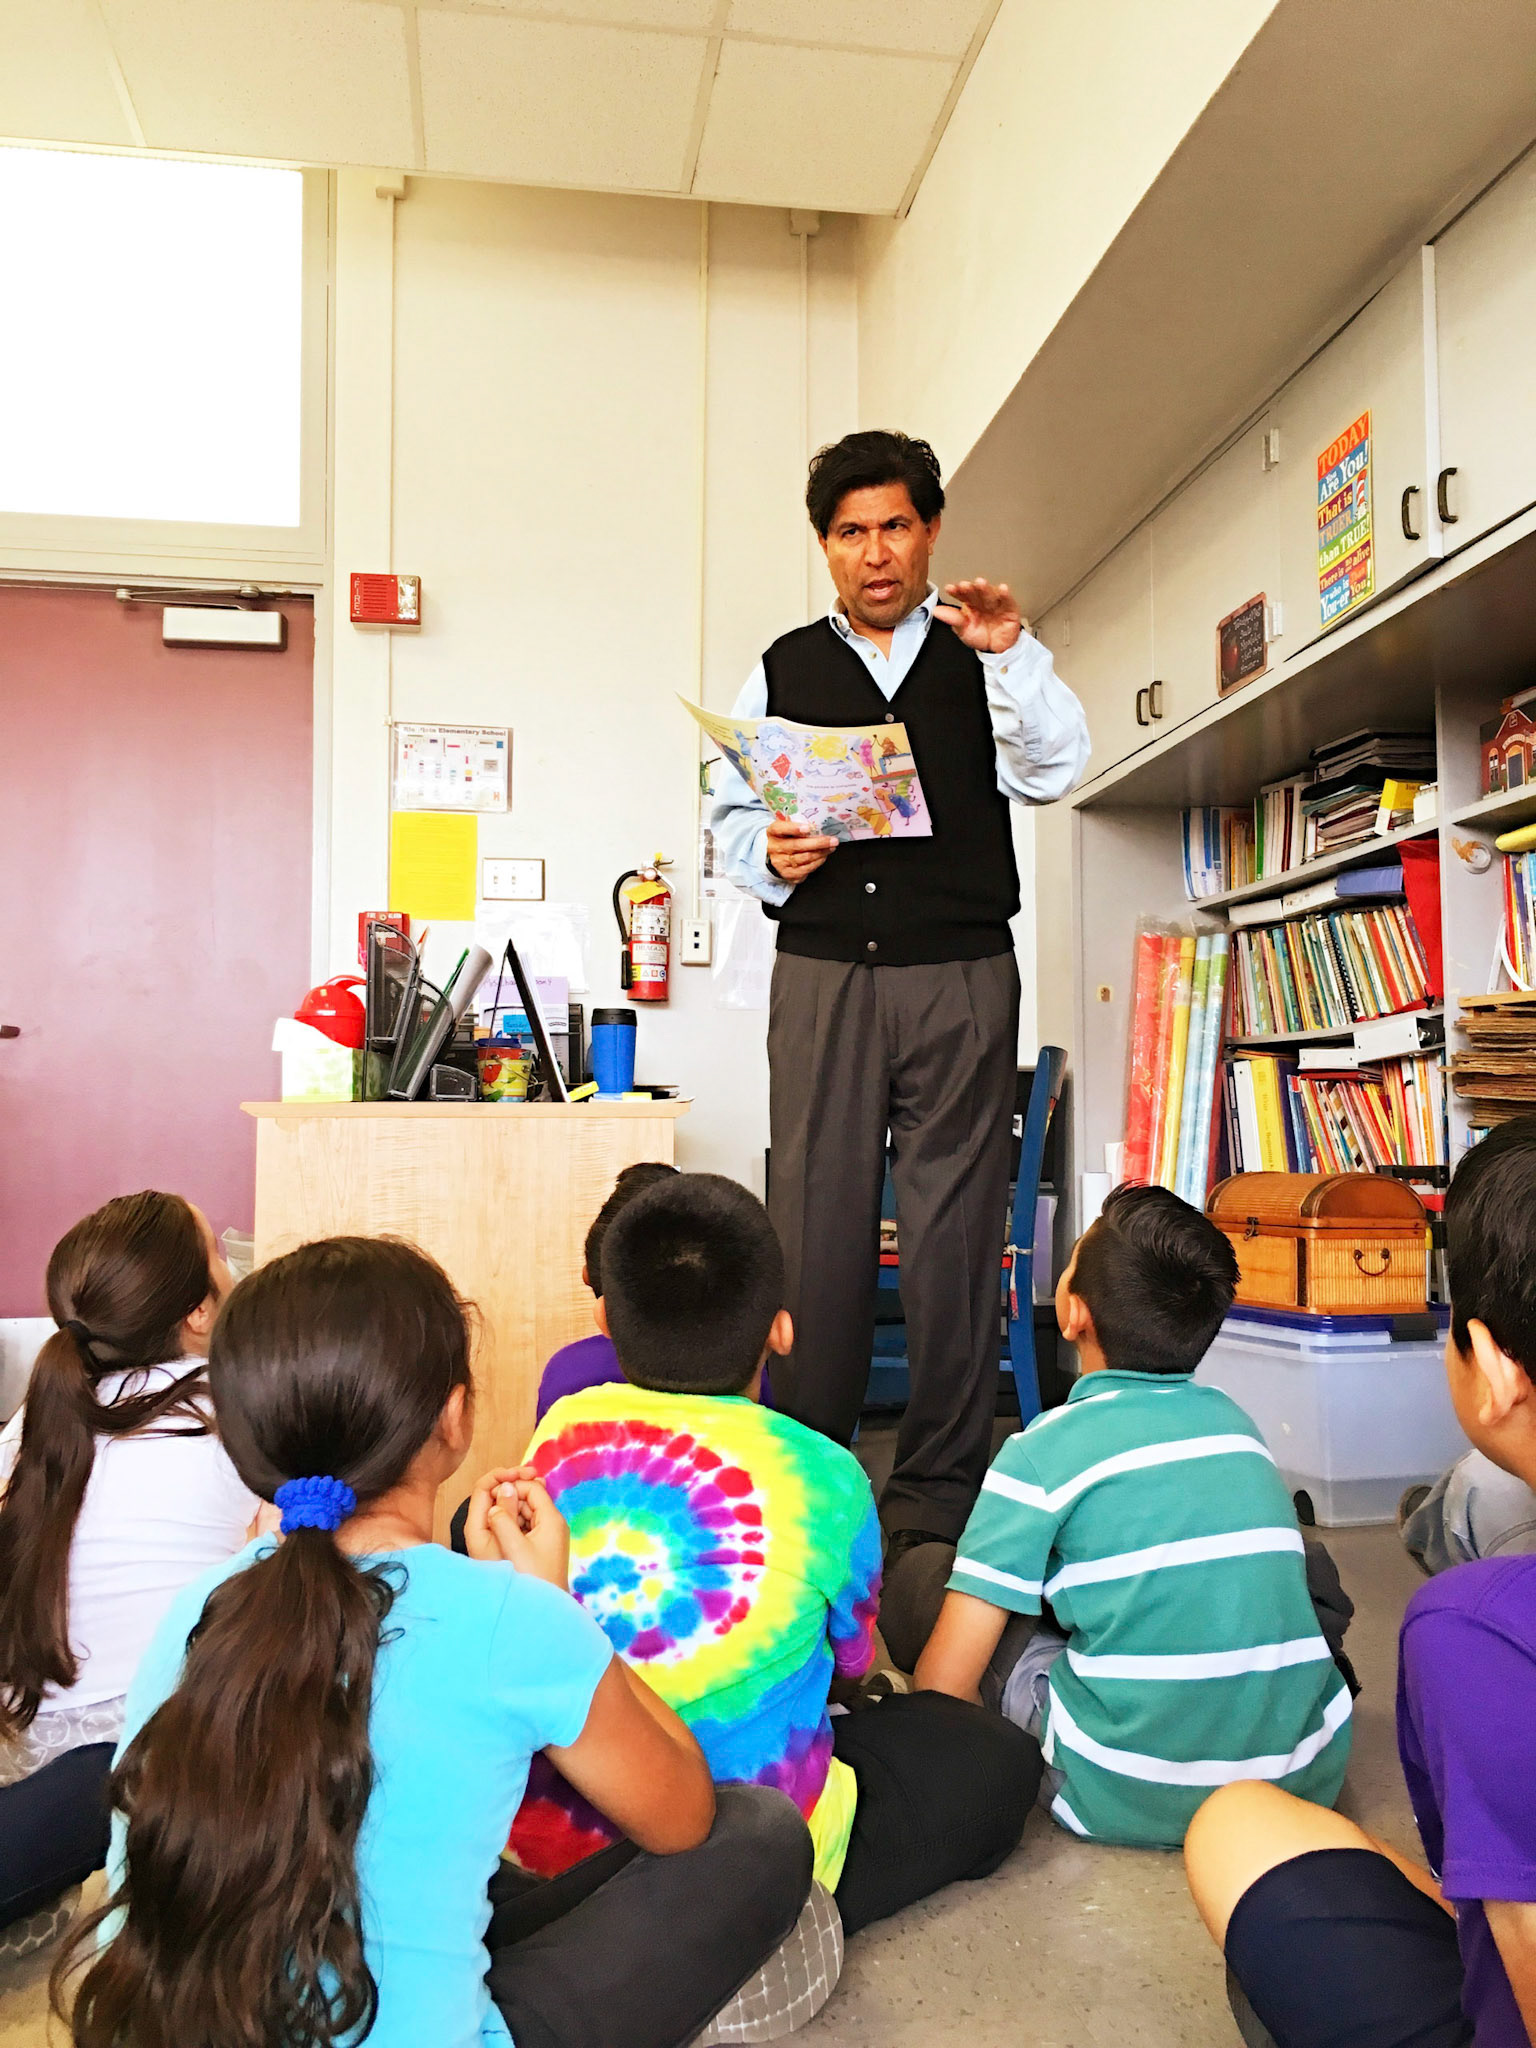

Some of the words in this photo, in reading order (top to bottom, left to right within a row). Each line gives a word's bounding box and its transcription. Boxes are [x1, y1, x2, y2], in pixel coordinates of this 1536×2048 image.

[1319, 411, 1369, 475] TODAY
[1320, 477, 1339, 503] Are
[1340, 440, 1368, 483] You!
[1320, 497, 1342, 528] That
[1344, 490, 1352, 507] is
[1320, 509, 1352, 546] TRUER
[1320, 545, 1340, 568] than
[1340, 515, 1370, 553] TRUE!
[1353, 547, 1370, 566] alive
[1320, 572, 1338, 591] There
[1338, 568, 1344, 577] is
[1329, 587, 1341, 599] who
[1343, 579, 1349, 590] is
[1321, 591, 1350, 620] You-er
[438, 728, 479, 736] Elementary
